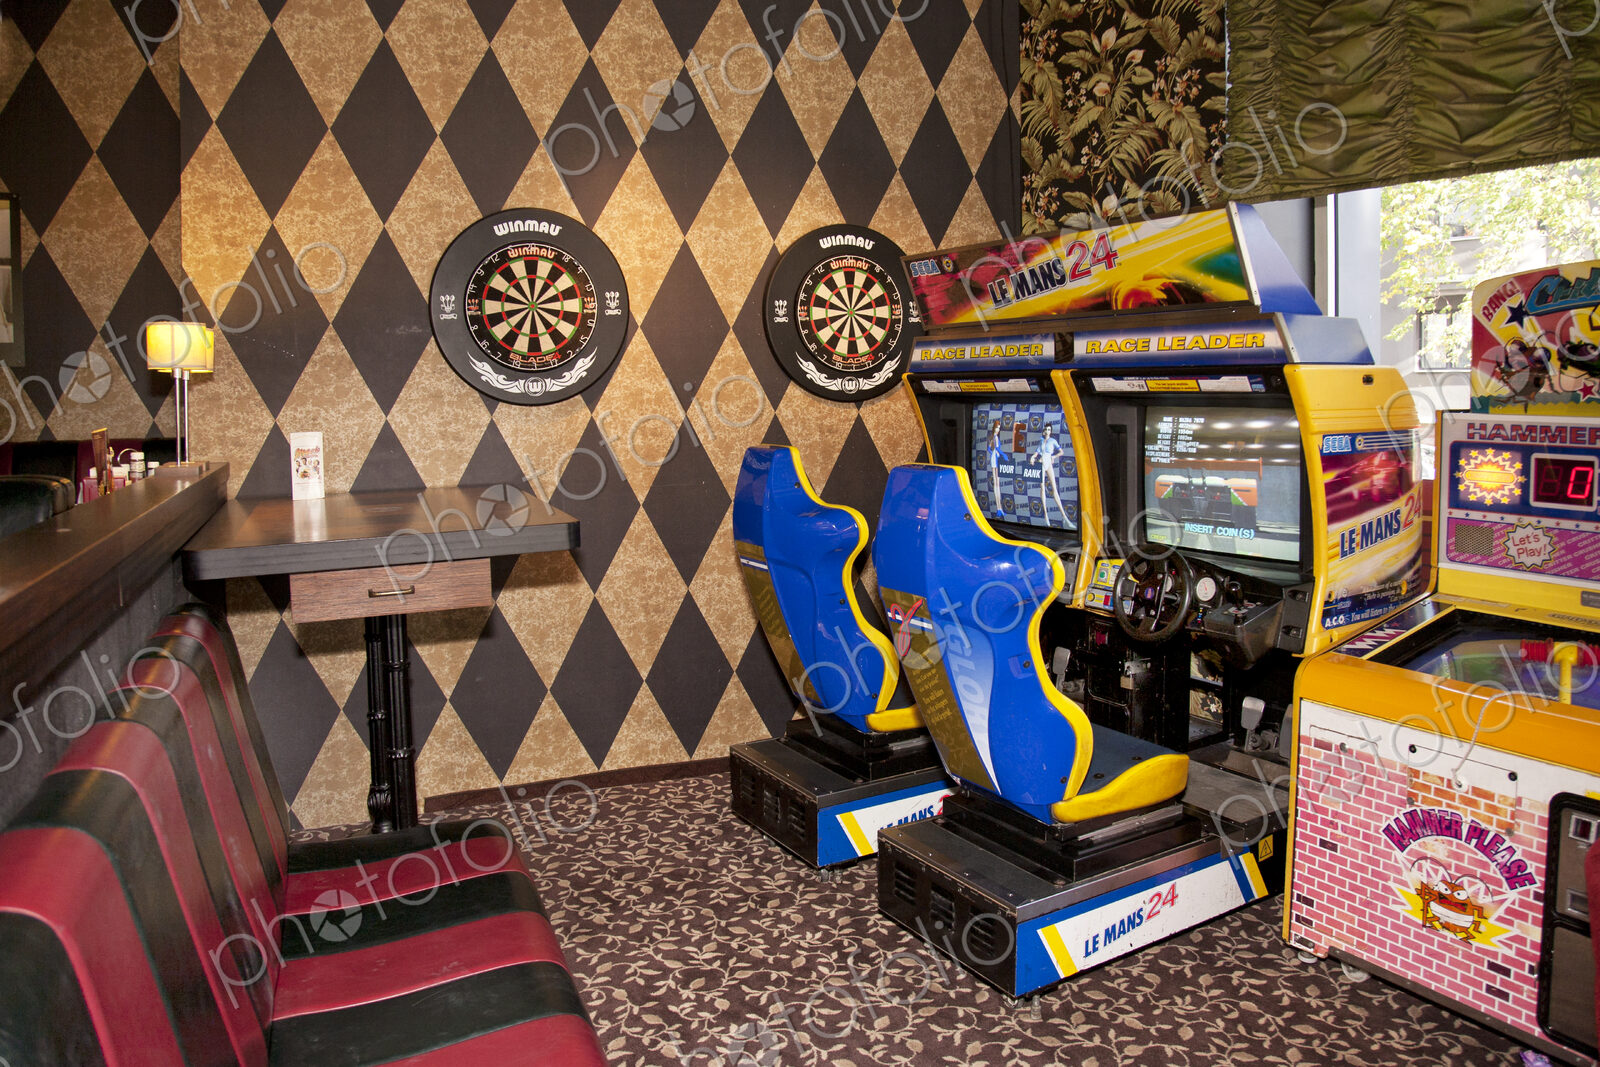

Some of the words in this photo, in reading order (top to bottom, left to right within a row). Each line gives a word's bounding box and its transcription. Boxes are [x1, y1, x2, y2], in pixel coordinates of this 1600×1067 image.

[493, 219, 562, 236] WINMAU
[819, 234, 875, 250] WINMAU
[507, 247, 557, 259] WINMAU
[829, 258, 871, 270] WINMAU
[910, 259, 941, 278] SEGA
[987, 278, 1013, 310] LE
[1009, 256, 1068, 303] MANS
[1065, 231, 1119, 283] 24
[1482, 280, 1521, 322] BANG!
[920, 348, 966, 361] RACE
[970, 343, 1044, 359] LEADER
[1086, 338, 1151, 354] RACE
[1157, 333, 1266, 352] LEADER
[1013, 422, 1027, 453] E
[1323, 435, 1352, 453] SEGA
[999, 464, 1015, 474] YOUR
[1023, 468, 1041, 479] RANK
[1567, 466, 1594, 498] 0
[1184, 522, 1214, 534] INSERT
[1340, 527, 1356, 559] LE
[1360, 508, 1401, 552] MANS
[1511, 532, 1540, 547] Let's
[1516, 544, 1547, 559] Play!
[1382, 808, 1463, 853] HAMMER
[1464, 819, 1538, 891] PLEASE
[1083, 932, 1099, 959] LE
[1103, 907, 1144, 947] MANS
[1145, 881, 1179, 921] 24
